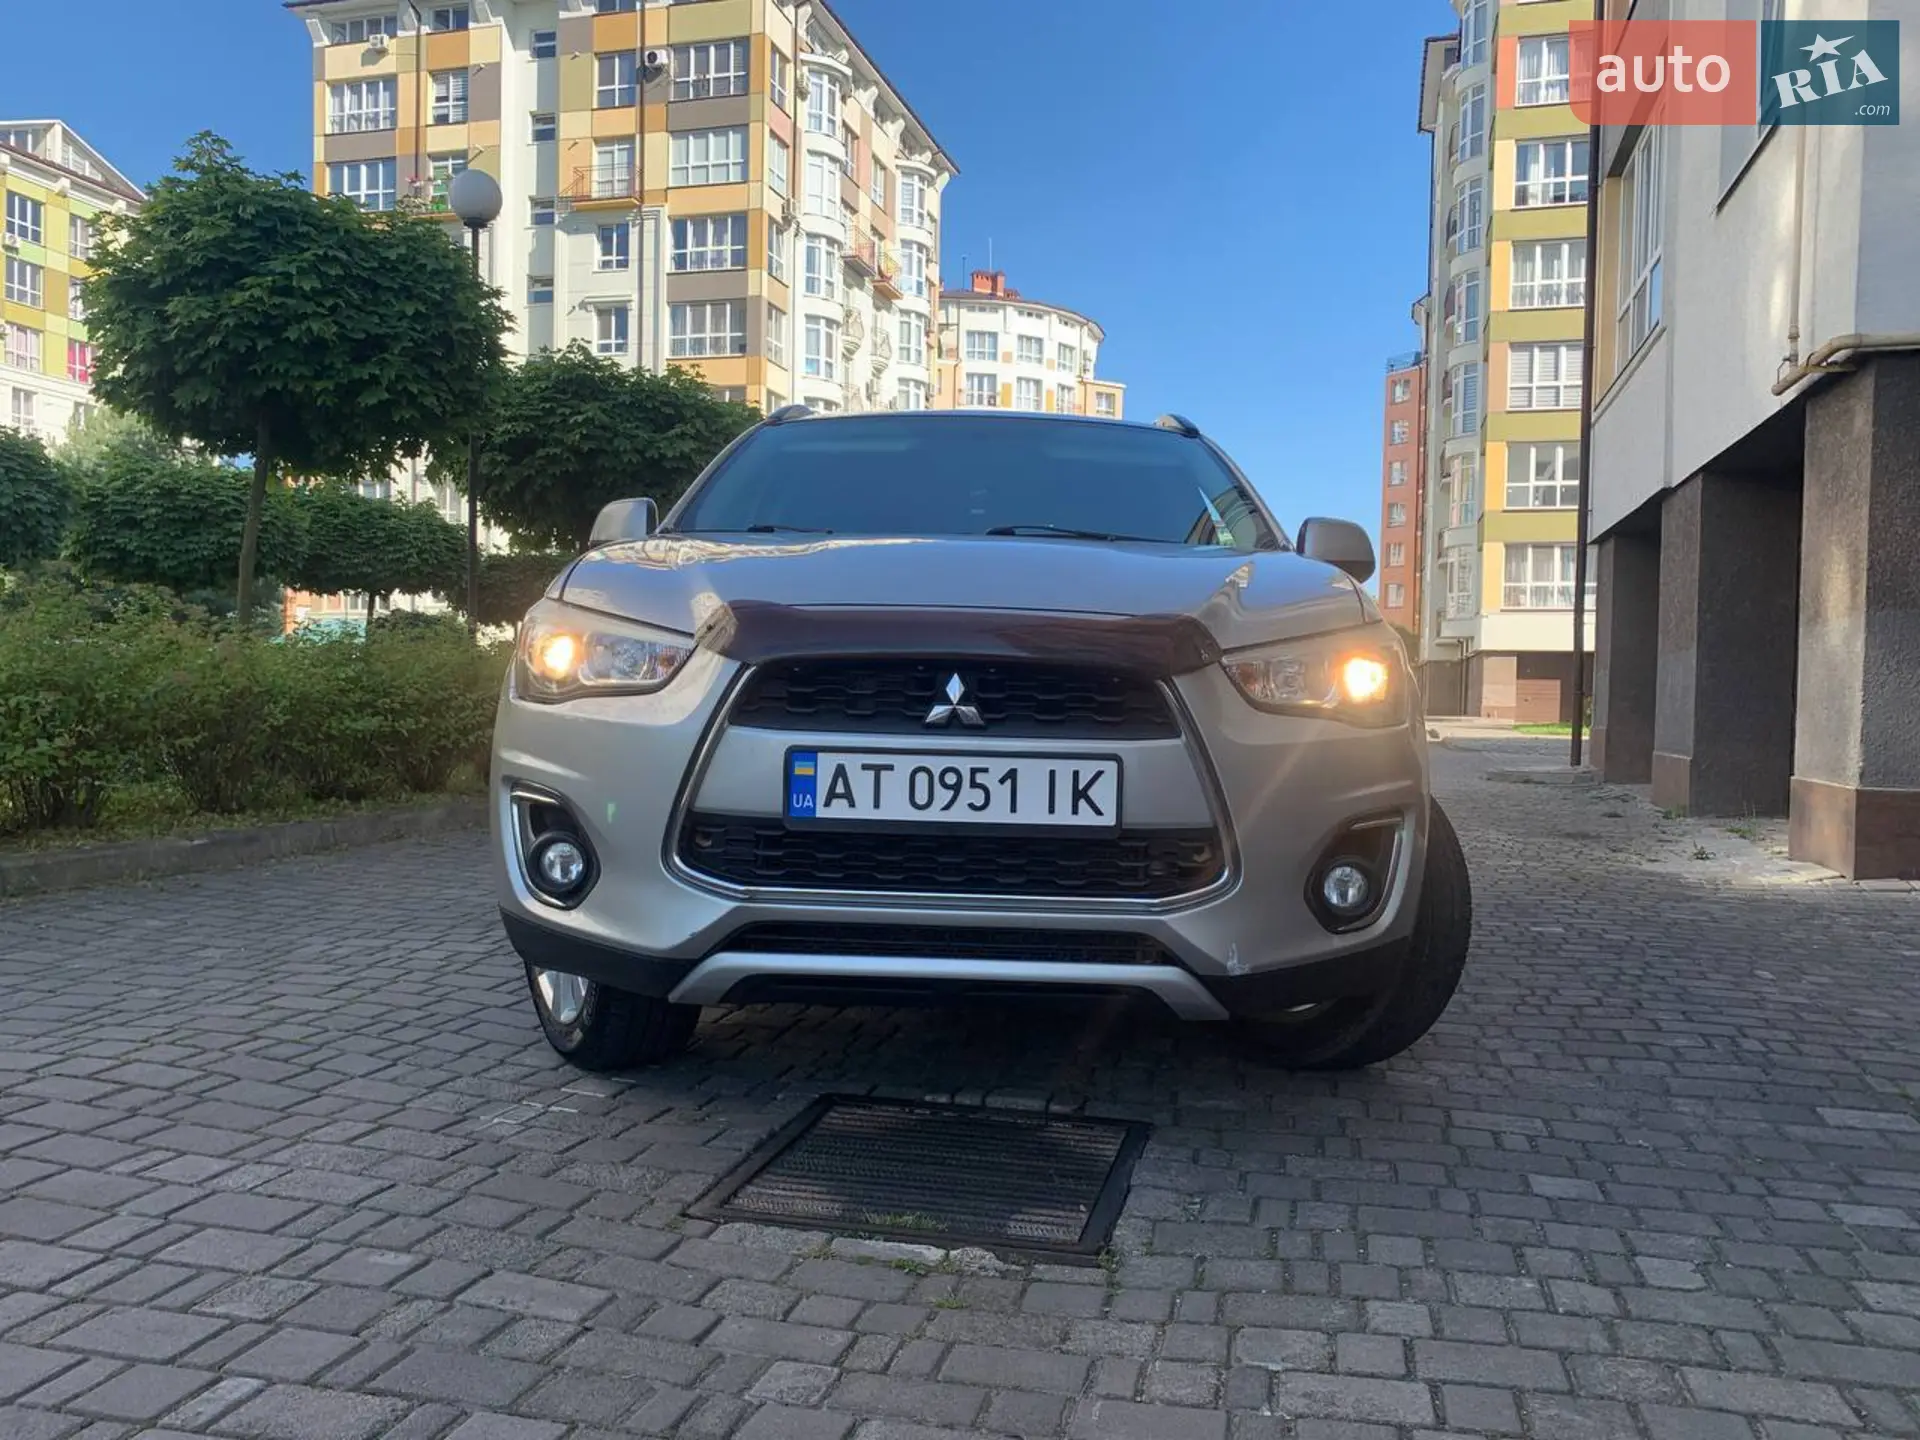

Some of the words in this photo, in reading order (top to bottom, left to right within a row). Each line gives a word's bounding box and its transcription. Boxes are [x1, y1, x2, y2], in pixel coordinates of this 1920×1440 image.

[792, 793, 814, 809] UA
[823, 763, 894, 809] AT
[908, 765, 1018, 814] 0951
[1048, 768, 1105, 816] IK
